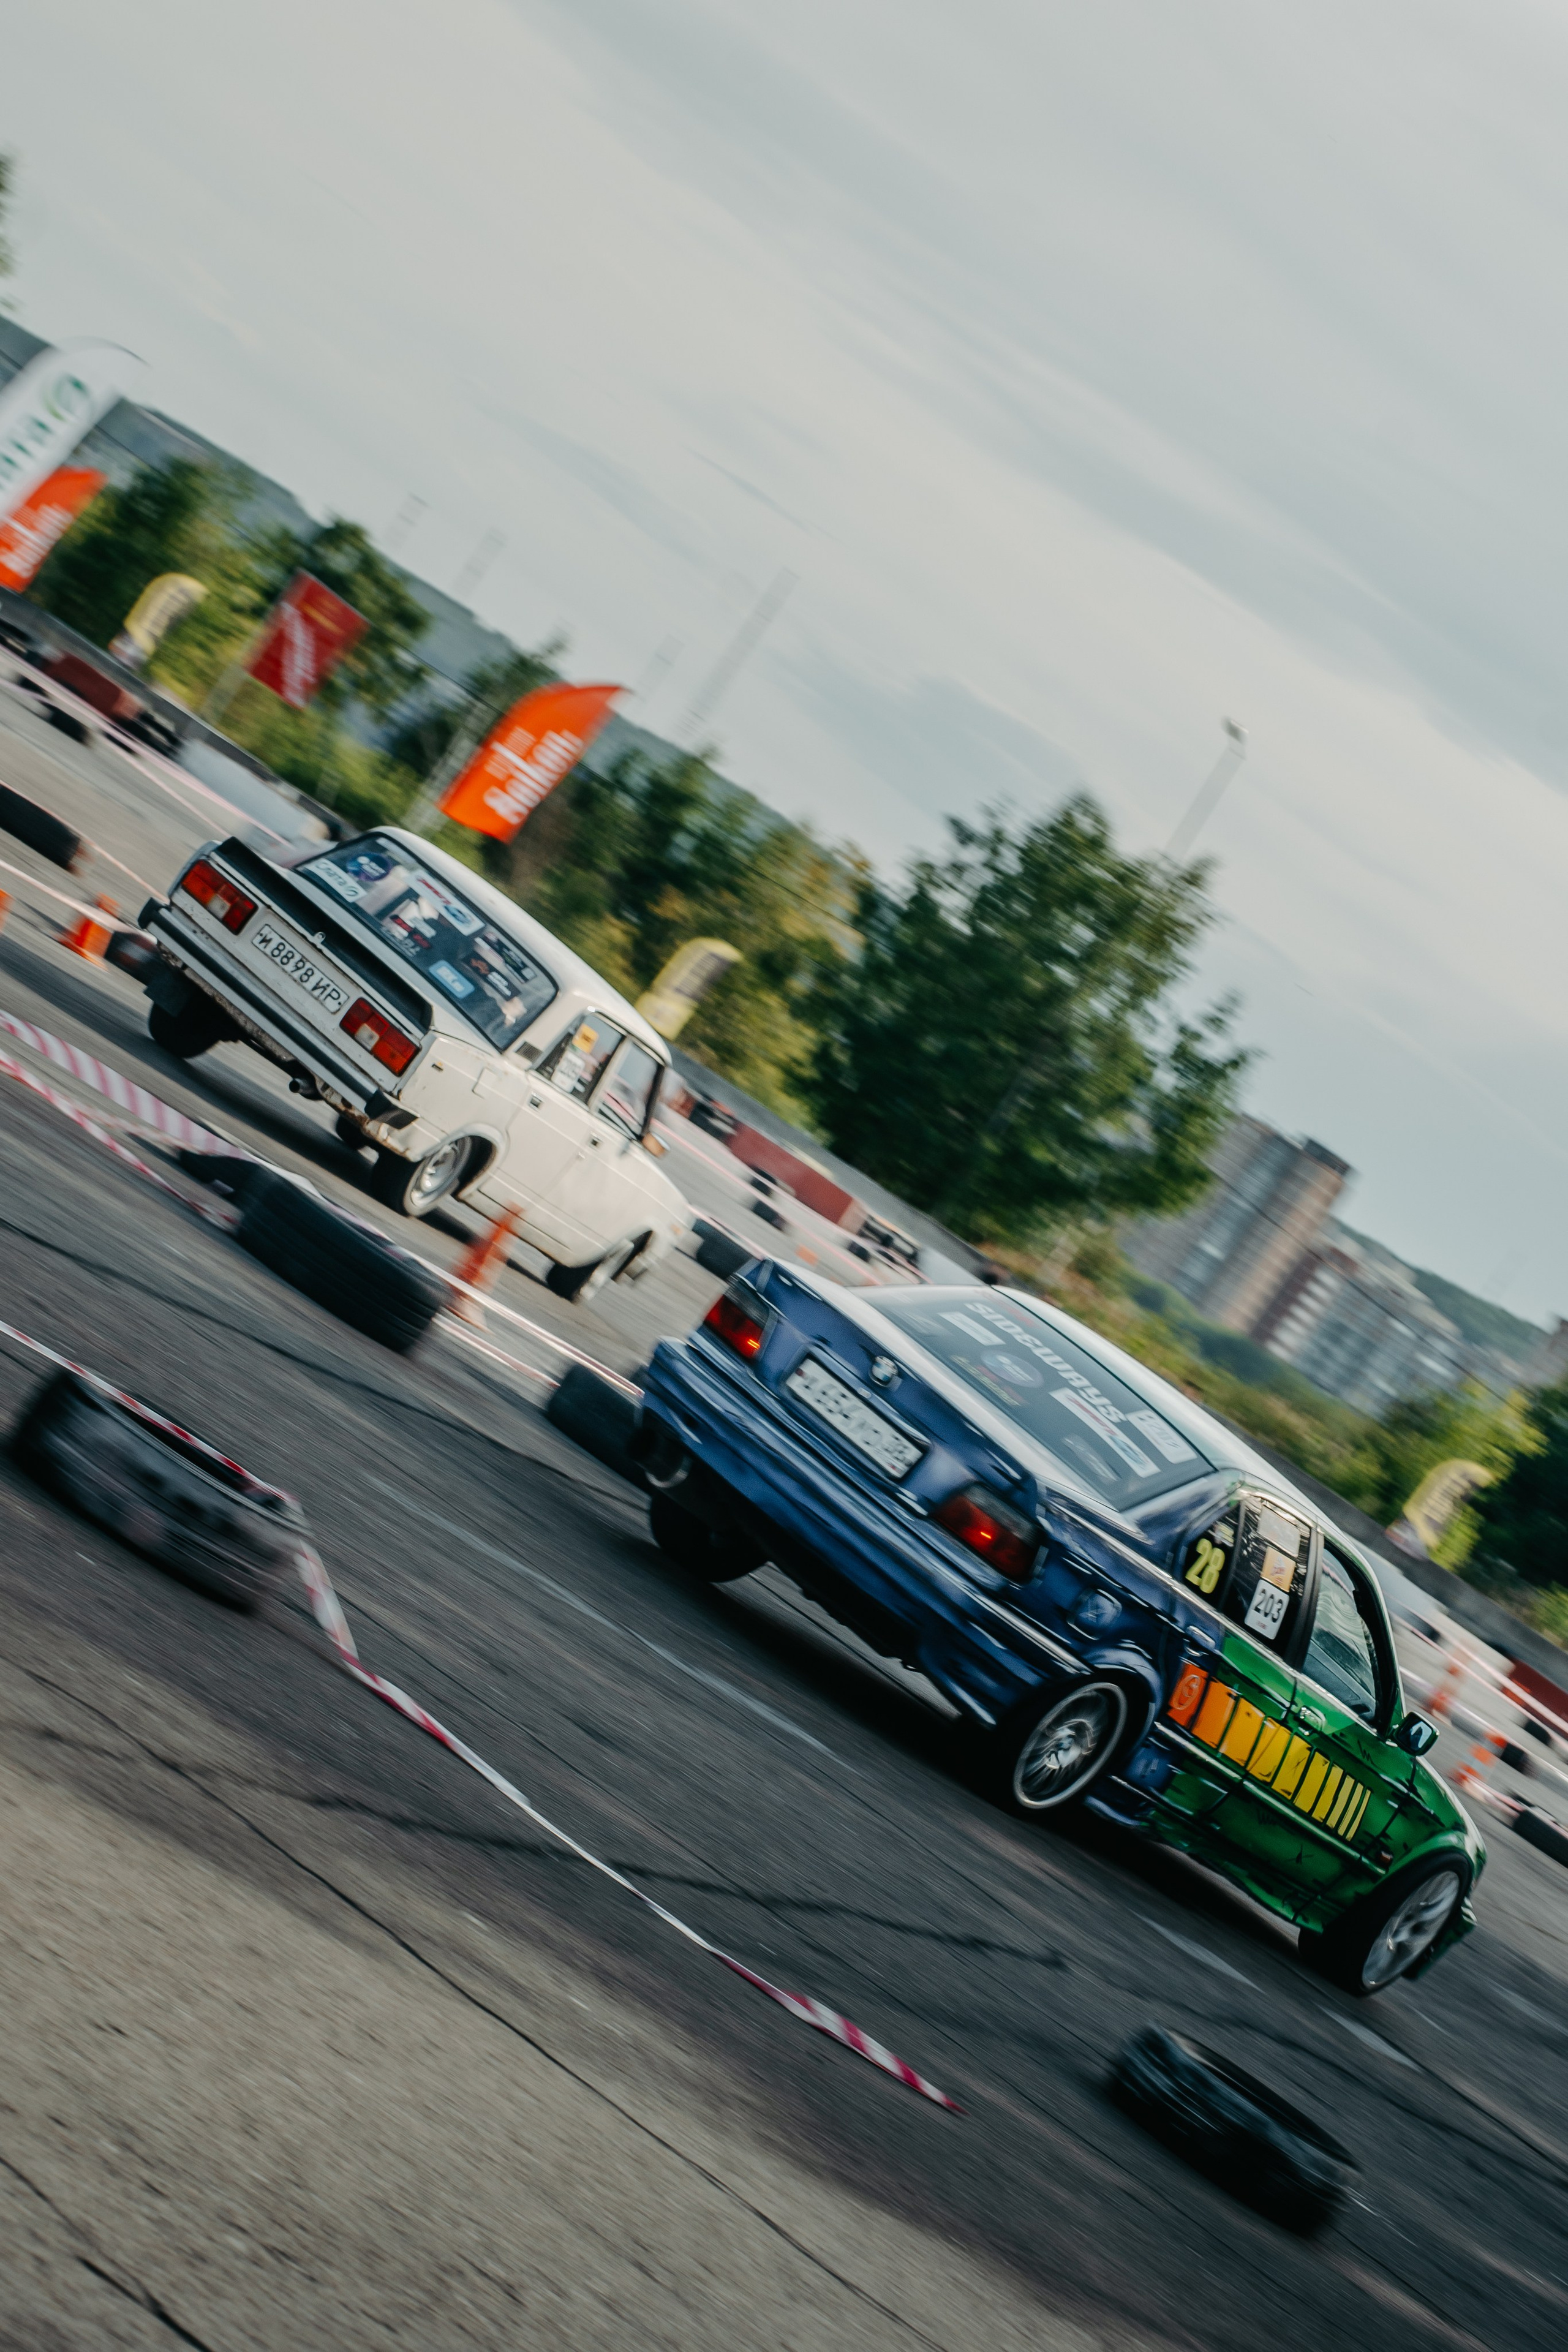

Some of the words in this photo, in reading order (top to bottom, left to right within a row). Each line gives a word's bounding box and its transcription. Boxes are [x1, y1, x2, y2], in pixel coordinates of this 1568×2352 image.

[964, 1302, 1128, 1423] SIDEWAYS
[1185, 1538, 1226, 1594] 28
[1254, 1588, 1283, 1623] 203
